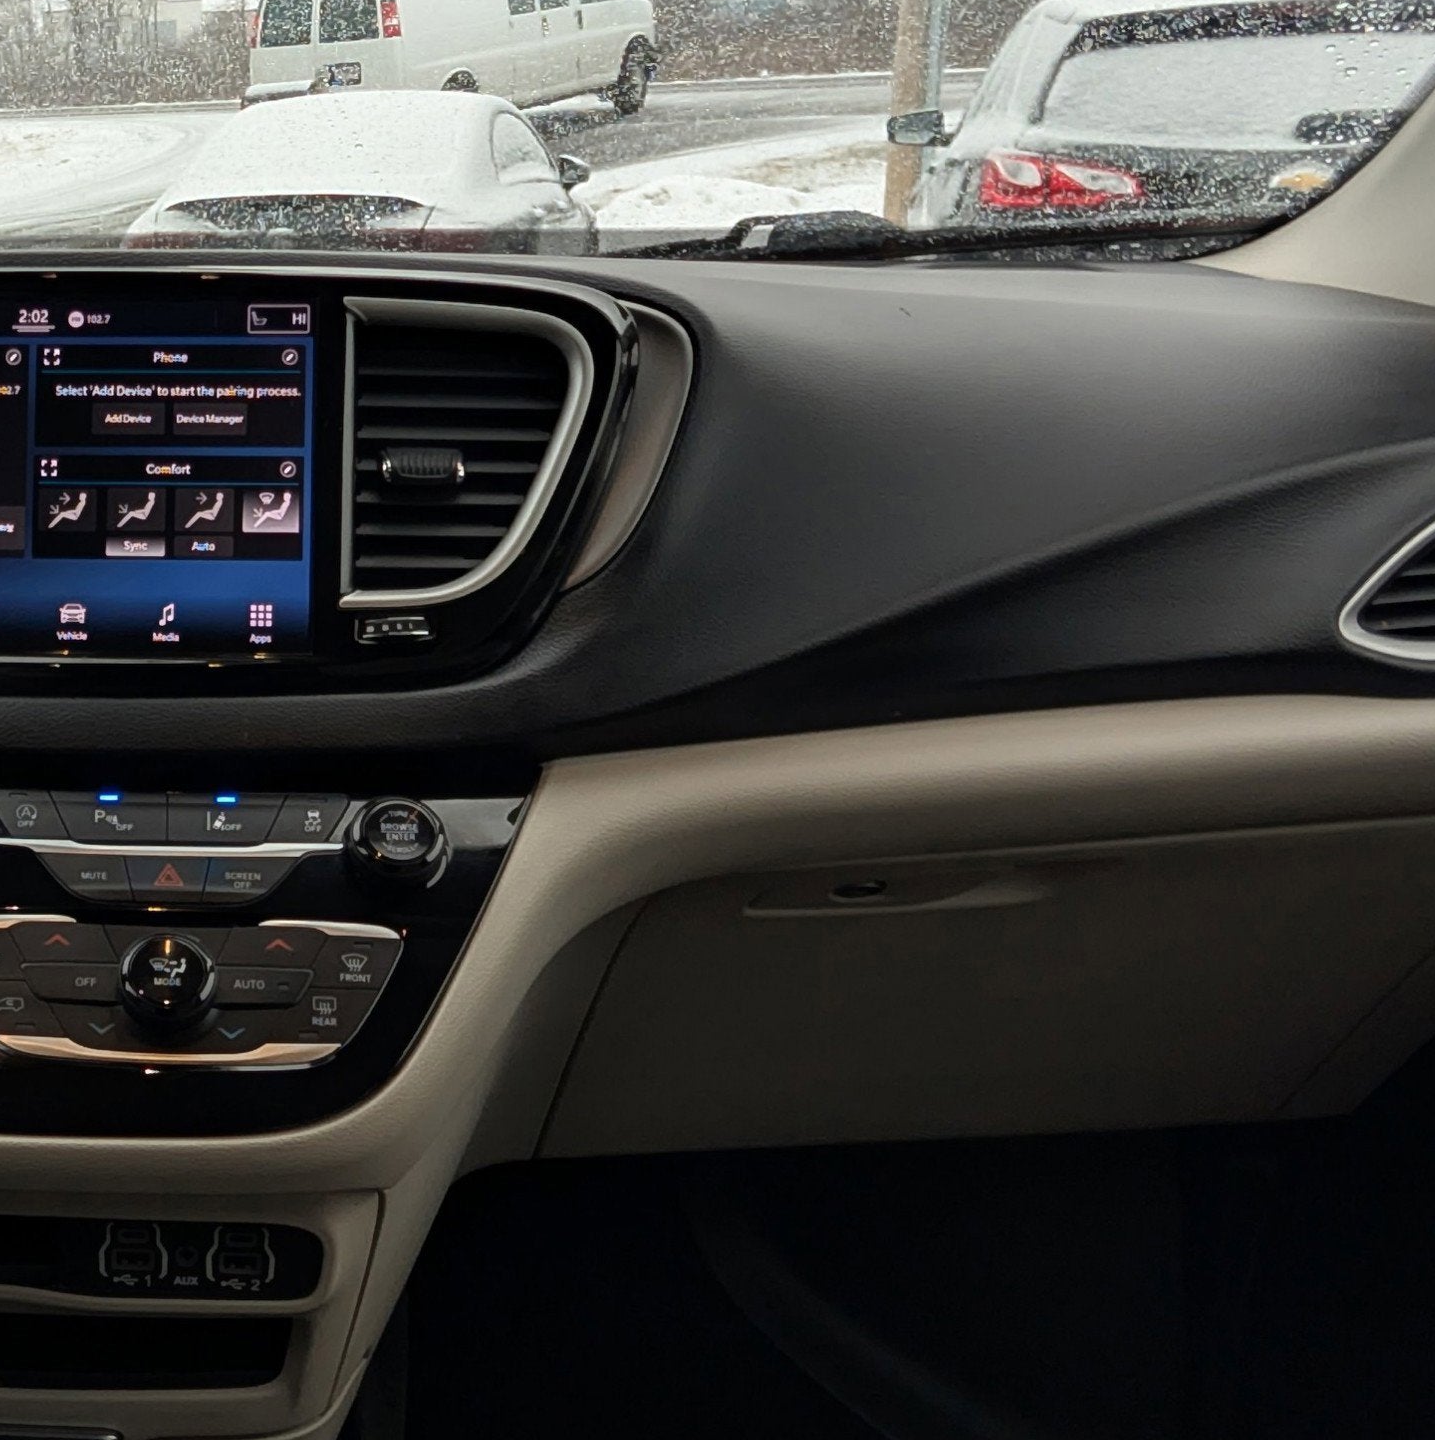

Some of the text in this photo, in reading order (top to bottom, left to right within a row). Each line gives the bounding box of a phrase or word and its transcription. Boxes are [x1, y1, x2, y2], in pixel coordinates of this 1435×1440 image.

[19, 309, 49, 323] 2:02
[87, 314, 110, 324] 102.7
[292, 312, 306, 325] HI
[153, 352, 188, 363] Phone
[55, 385, 87, 397] Select
[157, 386, 169, 397] to
[170, 386, 198, 397] start
[199, 385, 215, 397] the
[216, 386, 254, 399] pairing
[256, 387, 301, 399] process.
[105, 414, 151, 424] Add Device
[176, 414, 243, 425] Device Manager
[146, 464, 192, 475] Comfort
[123, 540, 148, 552] Sync
[191, 541, 216, 551] Auto
[56, 631, 88, 641] Vehicle
[152, 632, 179, 642] Media
[249, 634, 272, 644] Apps
[380, 823, 418, 832] BROWSE
[385, 833, 416, 842] ENTER
[225, 872, 261, 881] SCREEN
[234, 881, 251, 889] OFF
[75, 977, 97, 987] OFF
[154, 977, 181, 986] MODE
[340, 974, 371, 983] FRONT
[234, 979, 265, 990] AUTO
[312, 1018, 337, 1026] REAR
[144, 1275, 151, 1287] 1
[173, 1276, 199, 1285] AUX
[251, 1280, 260, 1291] 2
